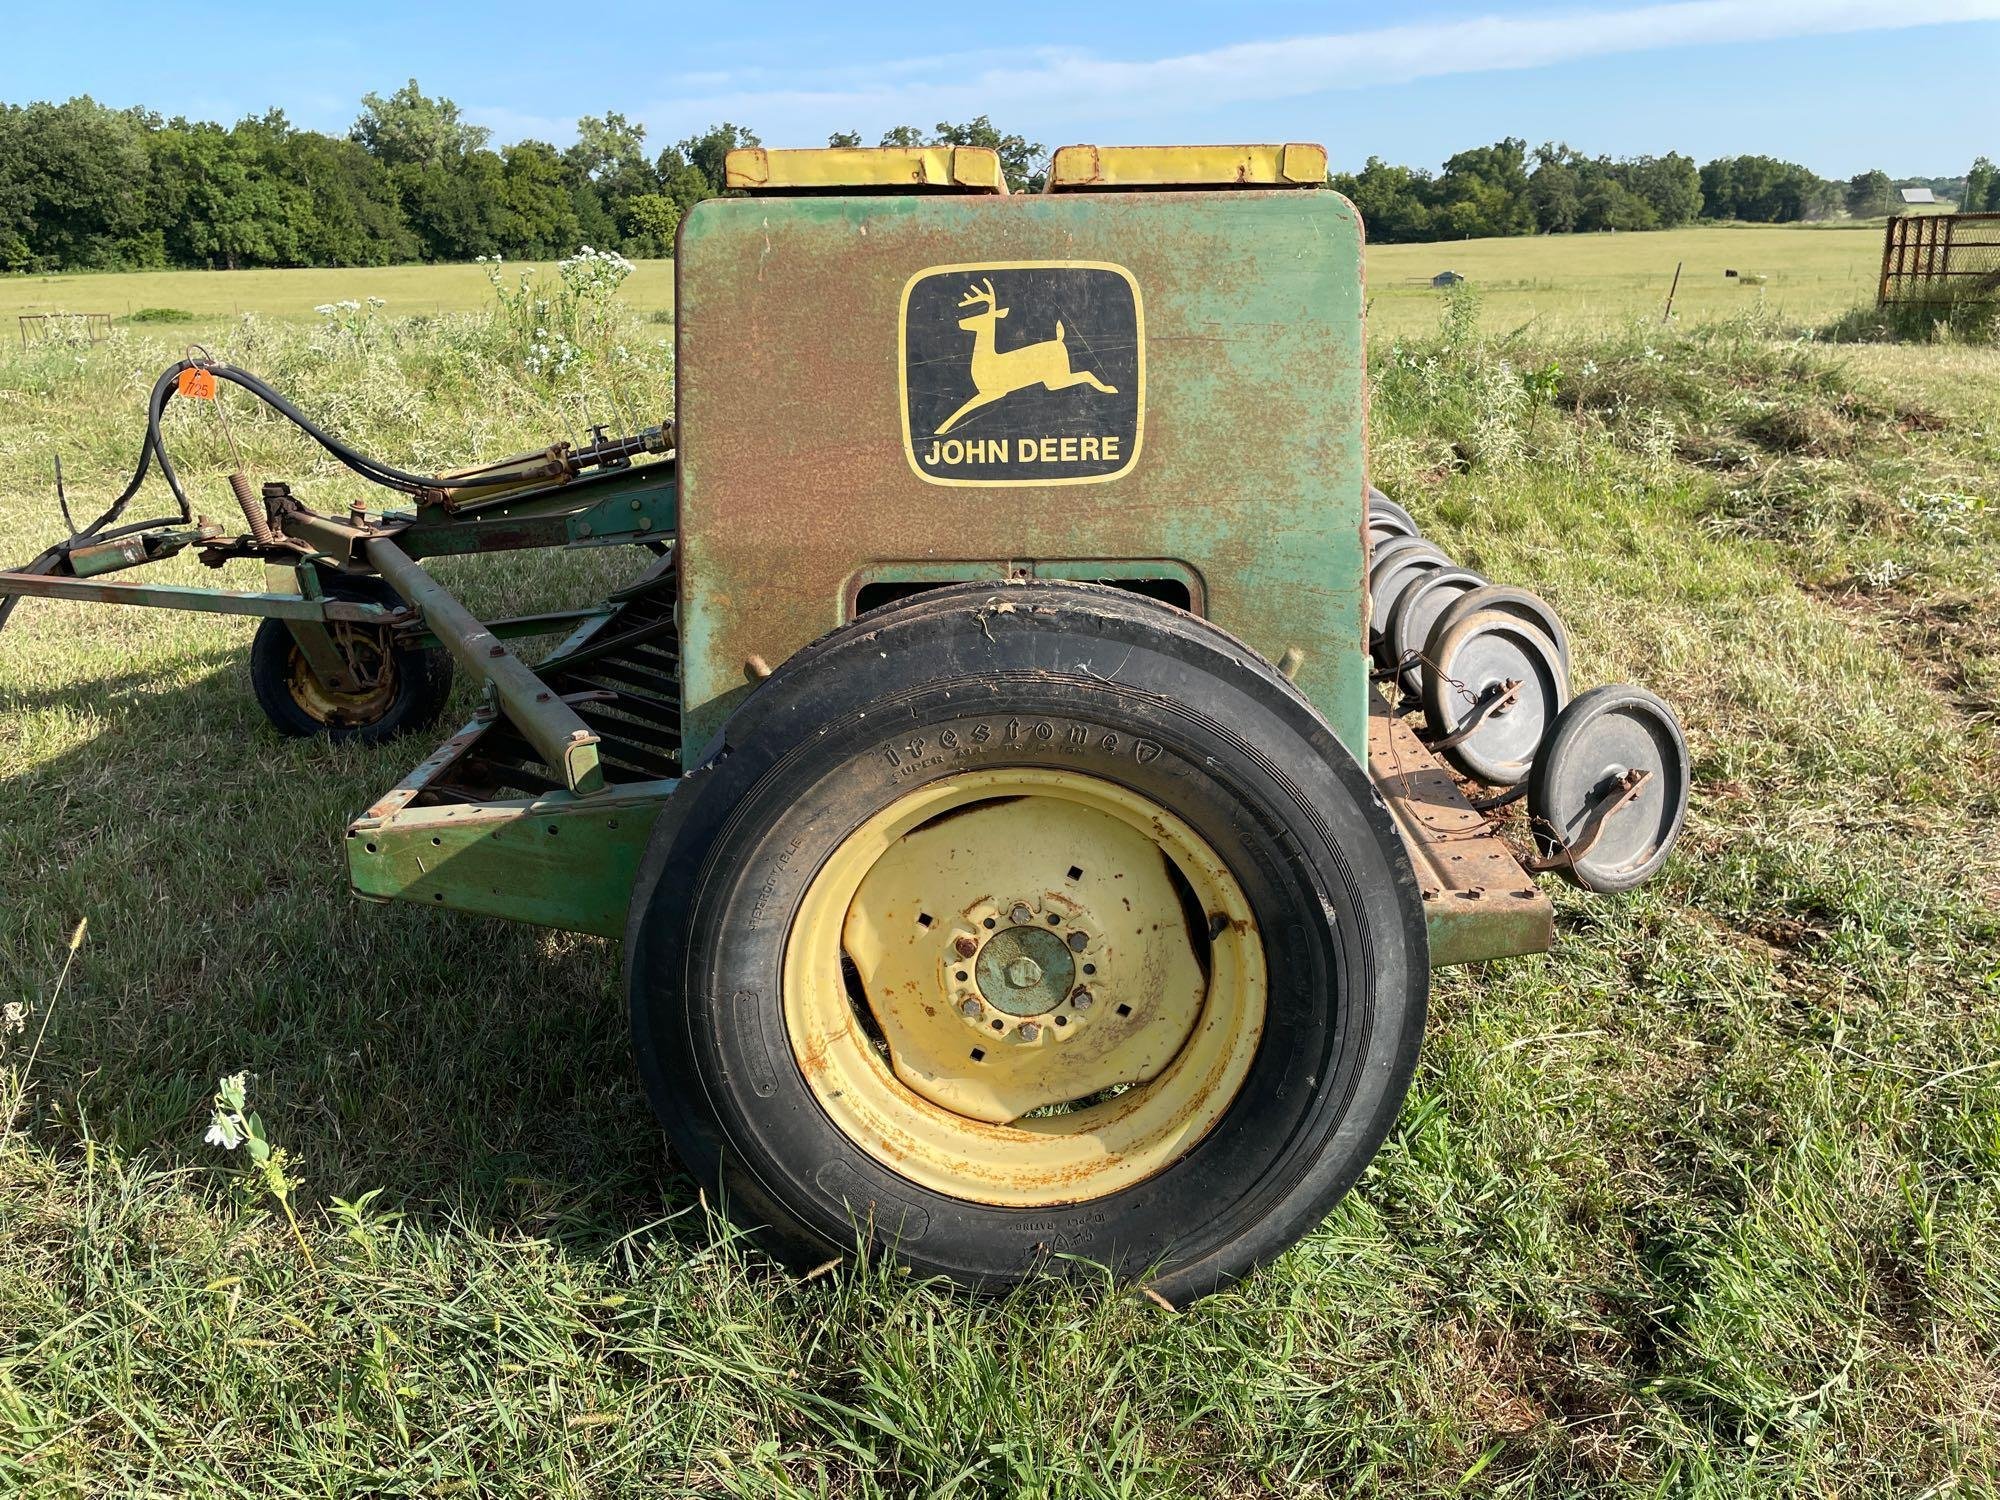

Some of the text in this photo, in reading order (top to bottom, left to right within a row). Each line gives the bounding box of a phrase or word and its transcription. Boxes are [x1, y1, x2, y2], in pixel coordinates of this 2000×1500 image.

[924, 436, 1120, 465] JOHN DEERE
[878, 716, 1120, 768] irestone
